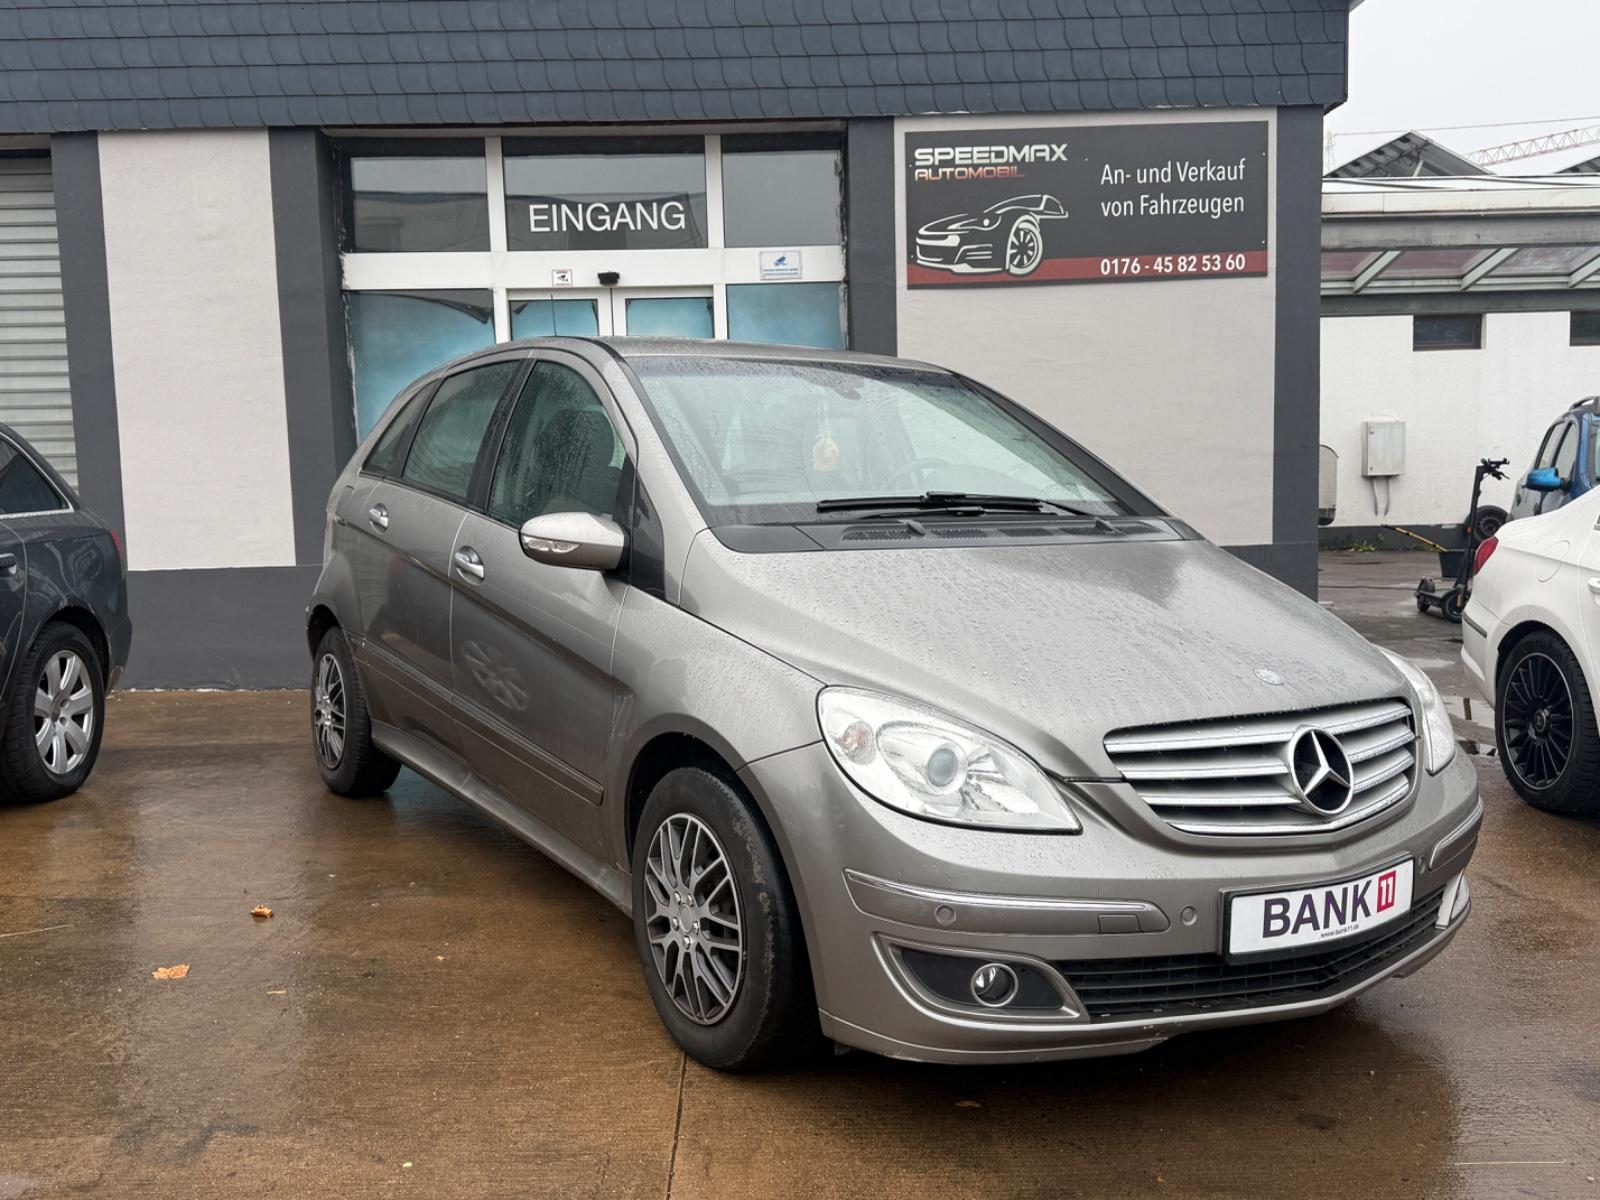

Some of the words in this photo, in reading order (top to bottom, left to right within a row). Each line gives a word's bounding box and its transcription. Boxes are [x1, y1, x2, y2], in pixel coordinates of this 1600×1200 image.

[914, 144, 1068, 166] SPEEDMAX
[914, 166, 1025, 181] AUTOMOBIL
[1101, 164, 1131, 185] An-
[1136, 161, 1171, 184] und
[1176, 158, 1246, 182] Verkauf
[529, 201, 686, 233] EINGANG
[1101, 200, 1134, 217] von
[1140, 195, 1245, 219] Fahrzeugen
[1101, 258, 1140, 275] 0176
[1153, 256, 1173, 274] 45
[1177, 255, 1197, 272] 82
[1201, 254, 1222, 271] 53
[1225, 254, 1245, 270] 60
